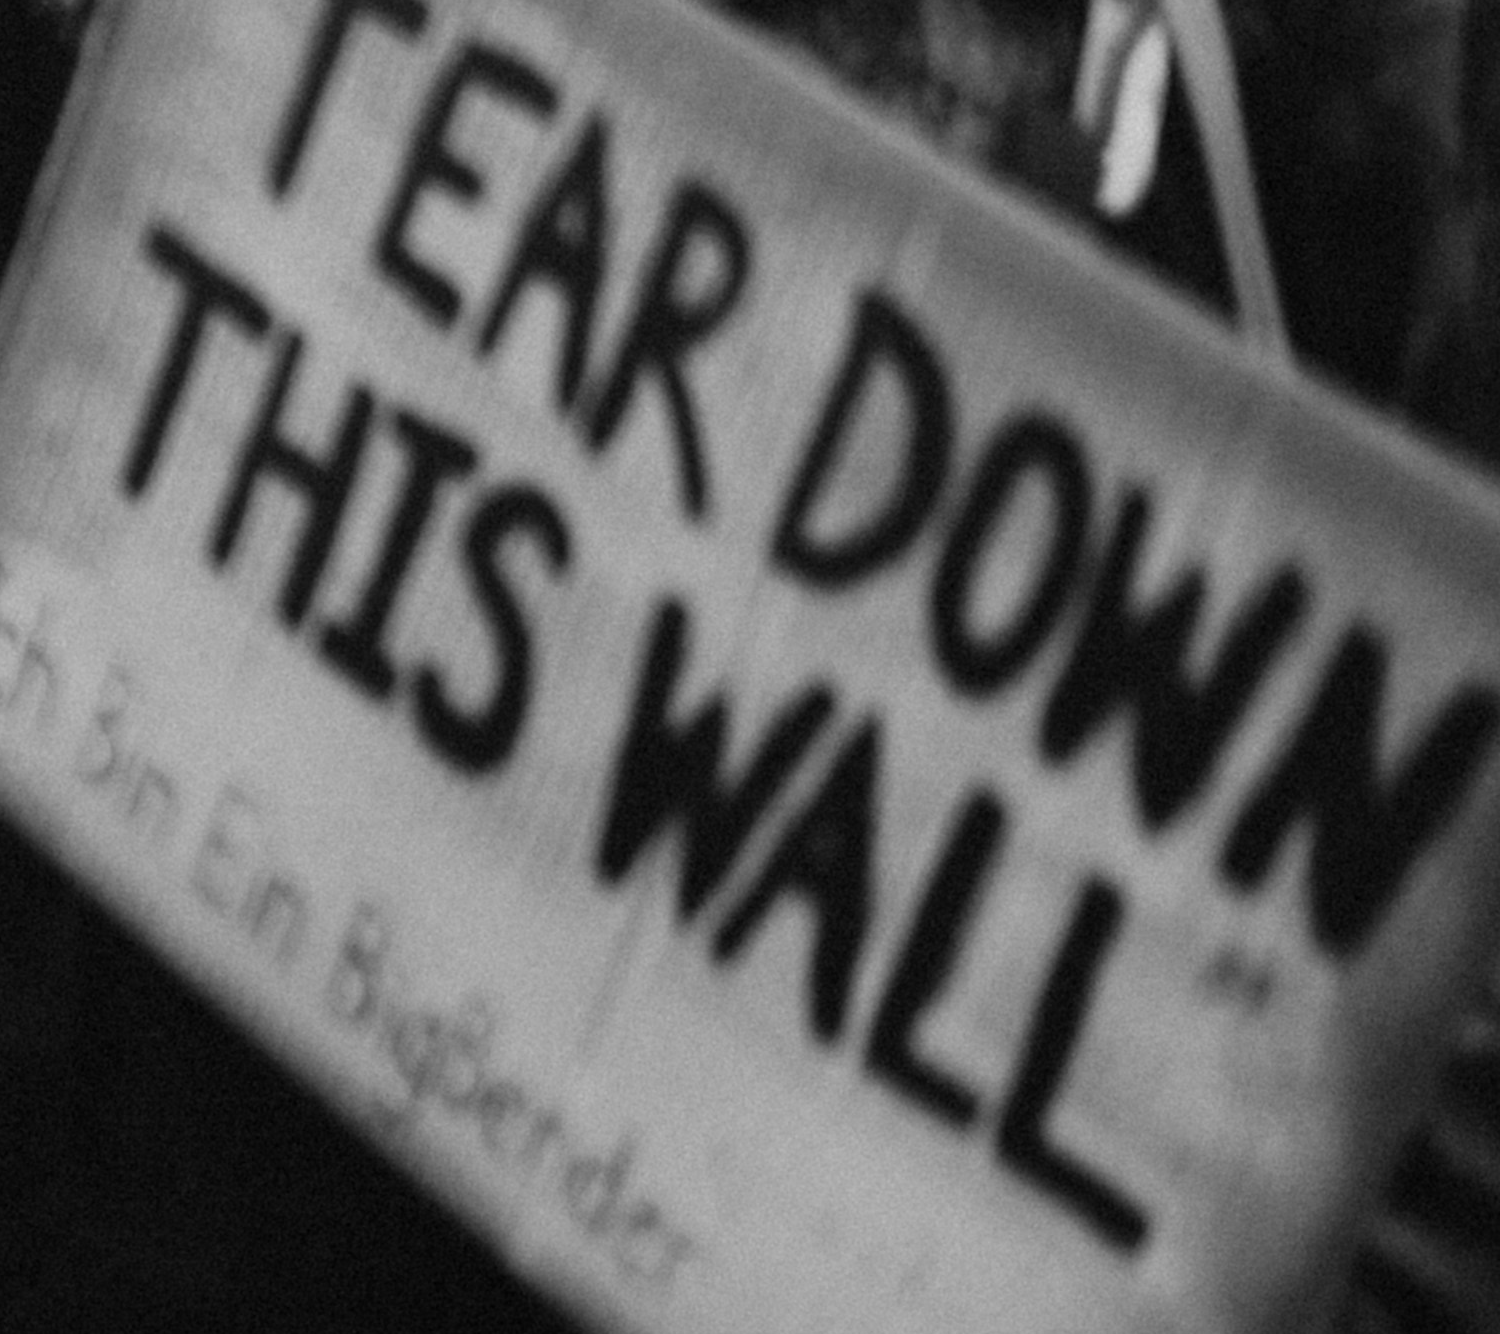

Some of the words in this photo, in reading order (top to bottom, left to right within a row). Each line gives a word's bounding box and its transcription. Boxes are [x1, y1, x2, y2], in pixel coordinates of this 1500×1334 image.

[122, 224, 574, 780] THIS
[770, 285, 1500, 964] DOWN
[189, 782, 312, 969] Ein
